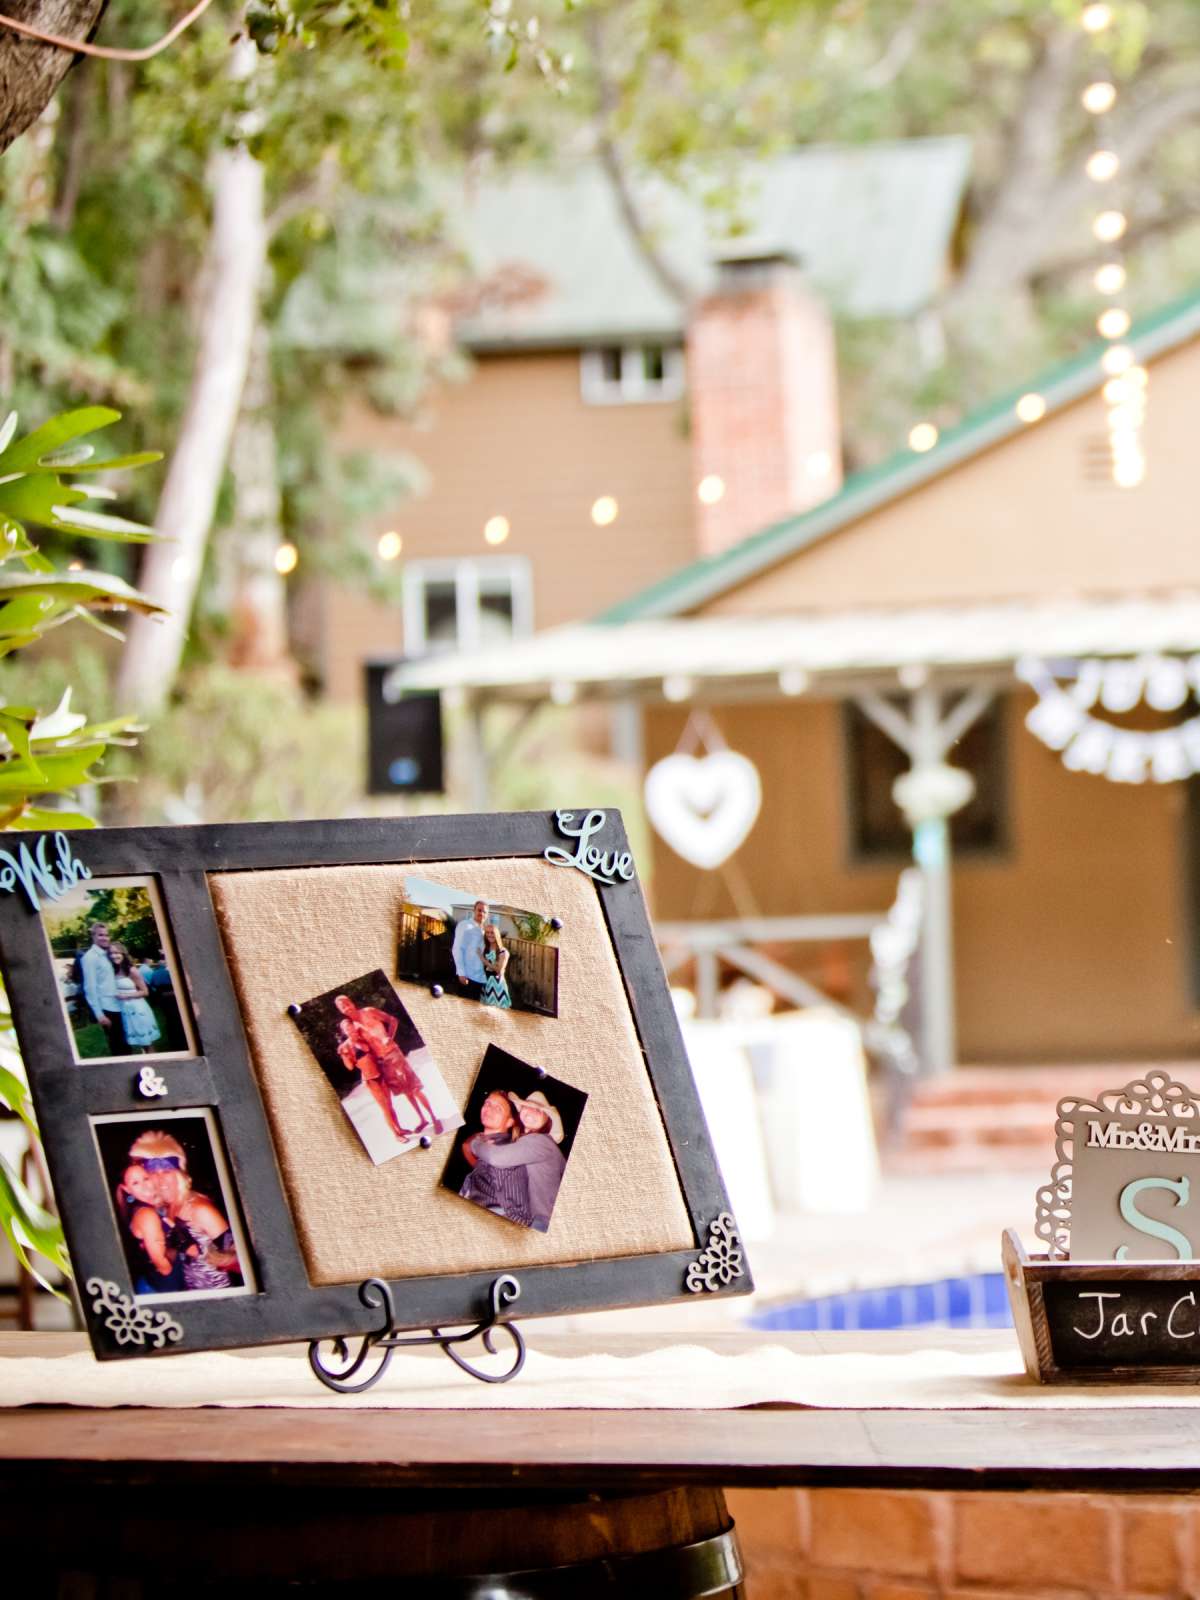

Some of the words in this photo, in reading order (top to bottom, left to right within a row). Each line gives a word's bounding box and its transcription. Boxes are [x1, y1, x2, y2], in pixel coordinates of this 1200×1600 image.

[0, 831, 92, 911] Wish
[544, 809, 634, 884] Love
[139, 1066, 168, 1096] &
[1115, 1175, 1193, 1260] S
[1073, 1292, 1158, 1340] Jar
